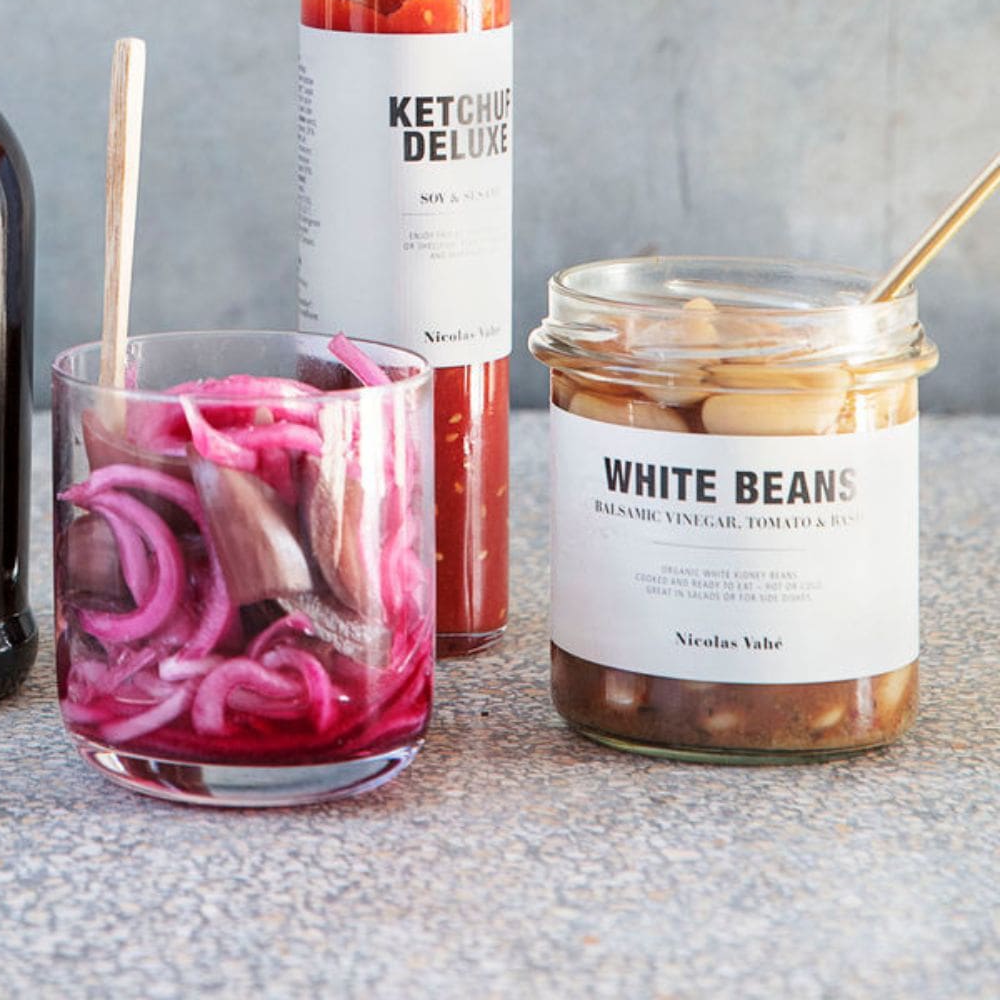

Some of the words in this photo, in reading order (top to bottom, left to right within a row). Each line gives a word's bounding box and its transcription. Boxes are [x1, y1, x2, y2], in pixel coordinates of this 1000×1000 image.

[403, 123, 508, 163] DELUXE
[420, 191, 446, 204] SOY
[604, 457, 717, 504] WHITE
[735, 468, 858, 505] BEANS
[594, 499, 661, 522] BALSAMIC
[747, 515, 813, 530] TOMATO
[816, 518, 826, 528] &
[675, 631, 738, 650] Nicolas
